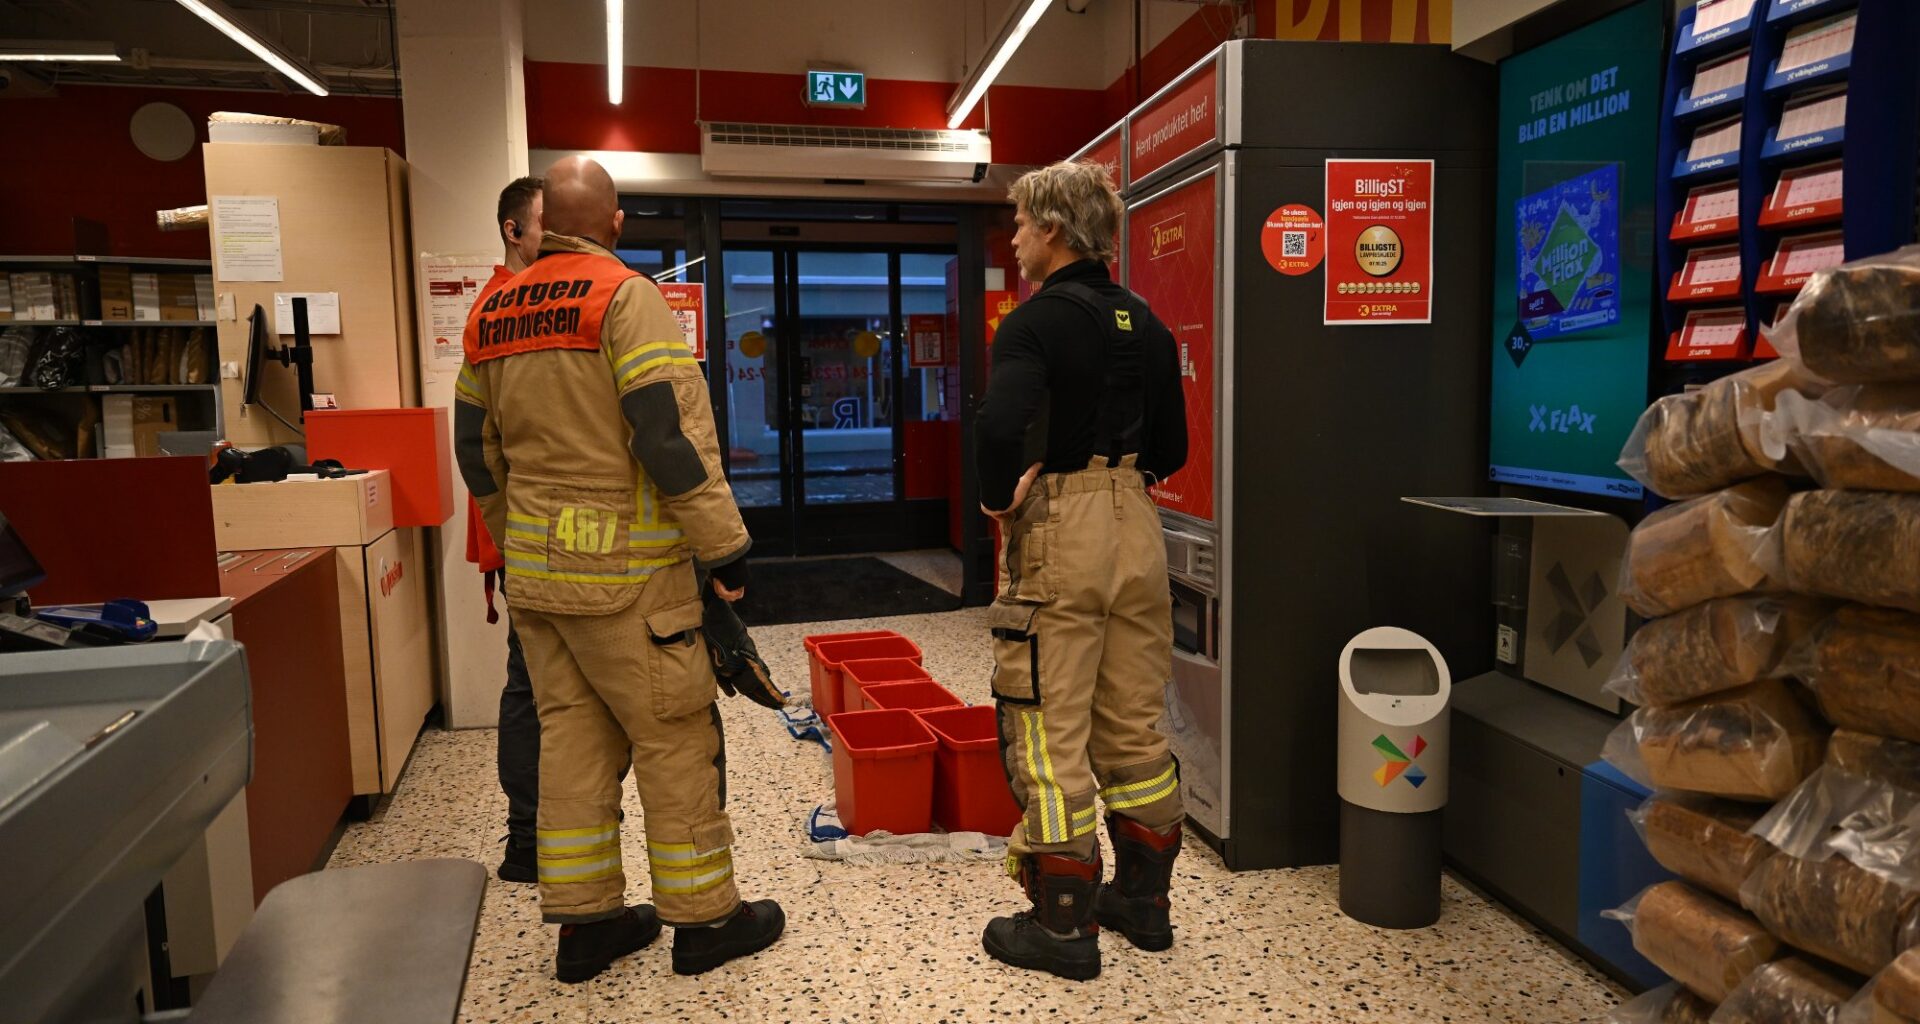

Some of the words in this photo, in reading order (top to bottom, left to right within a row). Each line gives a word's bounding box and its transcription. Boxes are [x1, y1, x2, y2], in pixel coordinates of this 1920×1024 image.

[1530, 84, 1564, 115] TENK
[1566, 77, 1587, 102] OM
[1591, 66, 1619, 95] DET
[1519, 117, 1547, 144] BLIR
[1549, 110, 1567, 134] EN
[1570, 89, 1630, 128] MILLION
[1135, 132, 1152, 159] Hent
[1152, 111, 1189, 153] produktet
[1190, 96, 1208, 126] her!
[1355, 178, 1405, 197] BilligST
[1332, 199, 1354, 212] igjen
[1356, 201, 1367, 212] og
[1369, 199, 1391, 212] igjen
[1393, 201, 1404, 212] og
[1405, 199, 1427, 212] igjen
[1794, 206, 1815, 217] LOTTO
[1161, 224, 1184, 244] EXTRA
[1698, 223, 1717, 232] LOTTO
[1359, 243, 1397, 252] BILLIGSTE
[1541, 238, 1588, 275] Million
[1553, 257, 1584, 285] Flax
[480, 279, 593, 313] Bergen
[665, 291, 687, 299] Julens
[1697, 286, 1714, 295] LOTTO
[1371, 304, 1398, 312] EXTRA
[1694, 349, 1711, 357] LOTTO
[1550, 404, 1597, 434] FLAX
[556, 506, 618, 554] 487
